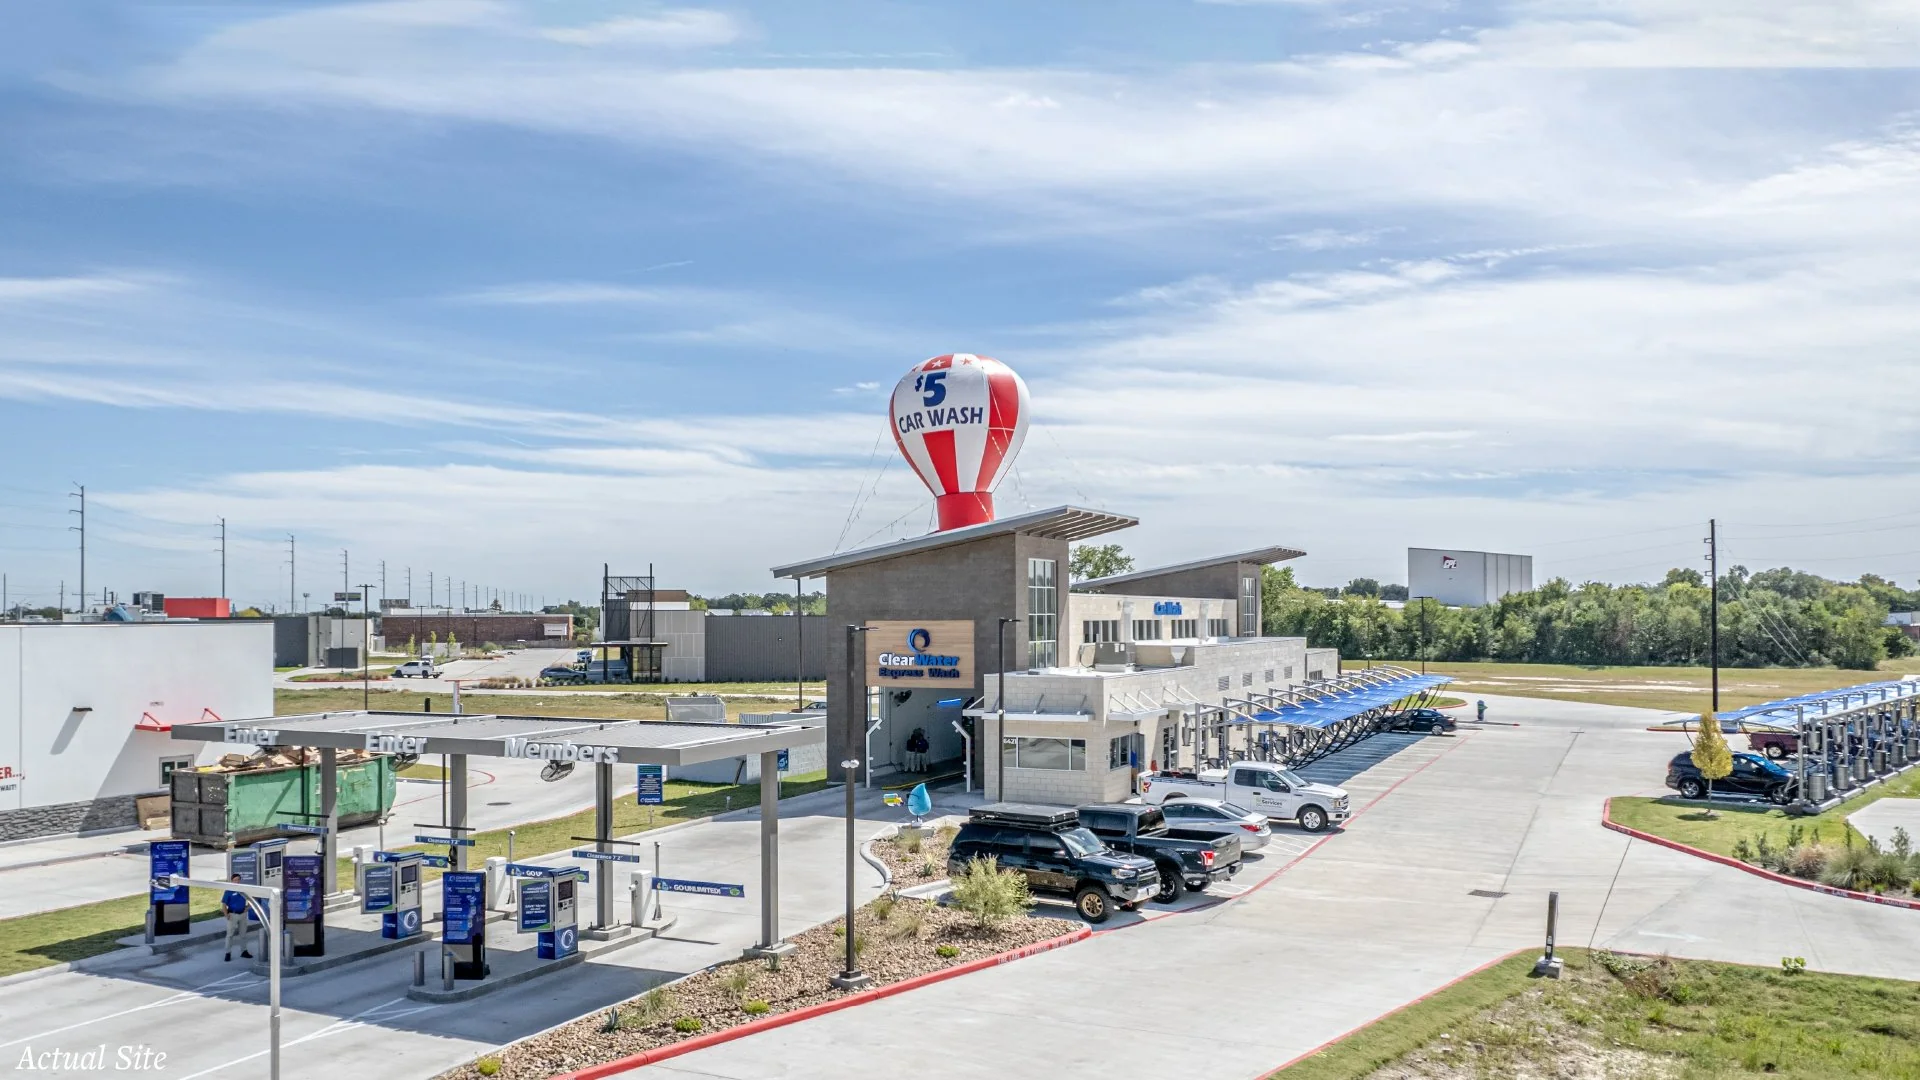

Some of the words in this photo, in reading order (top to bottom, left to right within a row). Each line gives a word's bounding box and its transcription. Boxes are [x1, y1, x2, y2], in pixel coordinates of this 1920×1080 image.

[914, 371, 947, 407] $5
[899, 411, 924, 433] CAR
[926, 406, 984, 427] WASH
[878, 652, 960, 668] ClearWater
[878, 667, 924, 680] Express
[927, 667, 960, 678] Wash
[223, 724, 279, 747] Enter
[365, 730, 428, 754] Enter
[504, 737, 619, 764] Members
[1261, 799, 1283, 807] Services
[586, 852, 612, 860] Clearance
